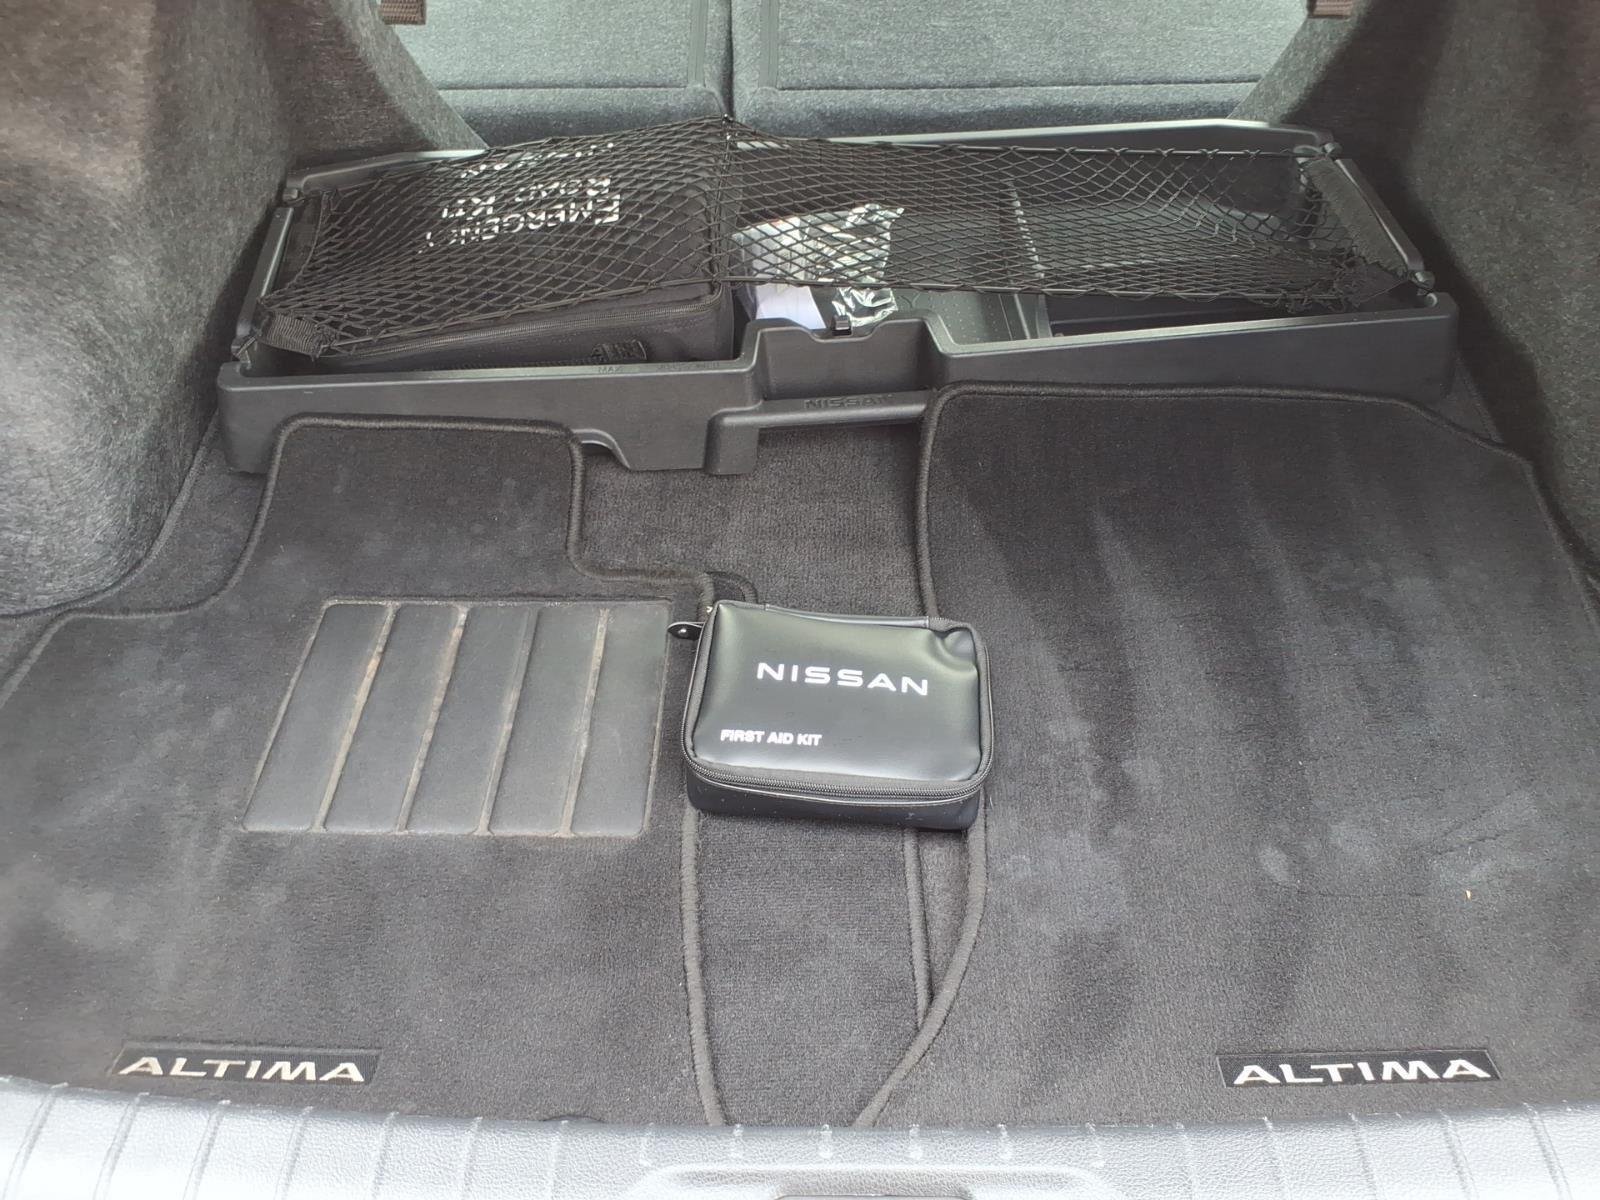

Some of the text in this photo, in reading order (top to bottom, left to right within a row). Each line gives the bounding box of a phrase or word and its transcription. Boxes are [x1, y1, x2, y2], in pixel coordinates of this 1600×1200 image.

[756, 661, 929, 697] NISSAN
[720, 728, 823, 746] FIRST AID KIT
[118, 1056, 366, 1083] ALTIMA
[1232, 1058, 1492, 1086] ALTIMA
